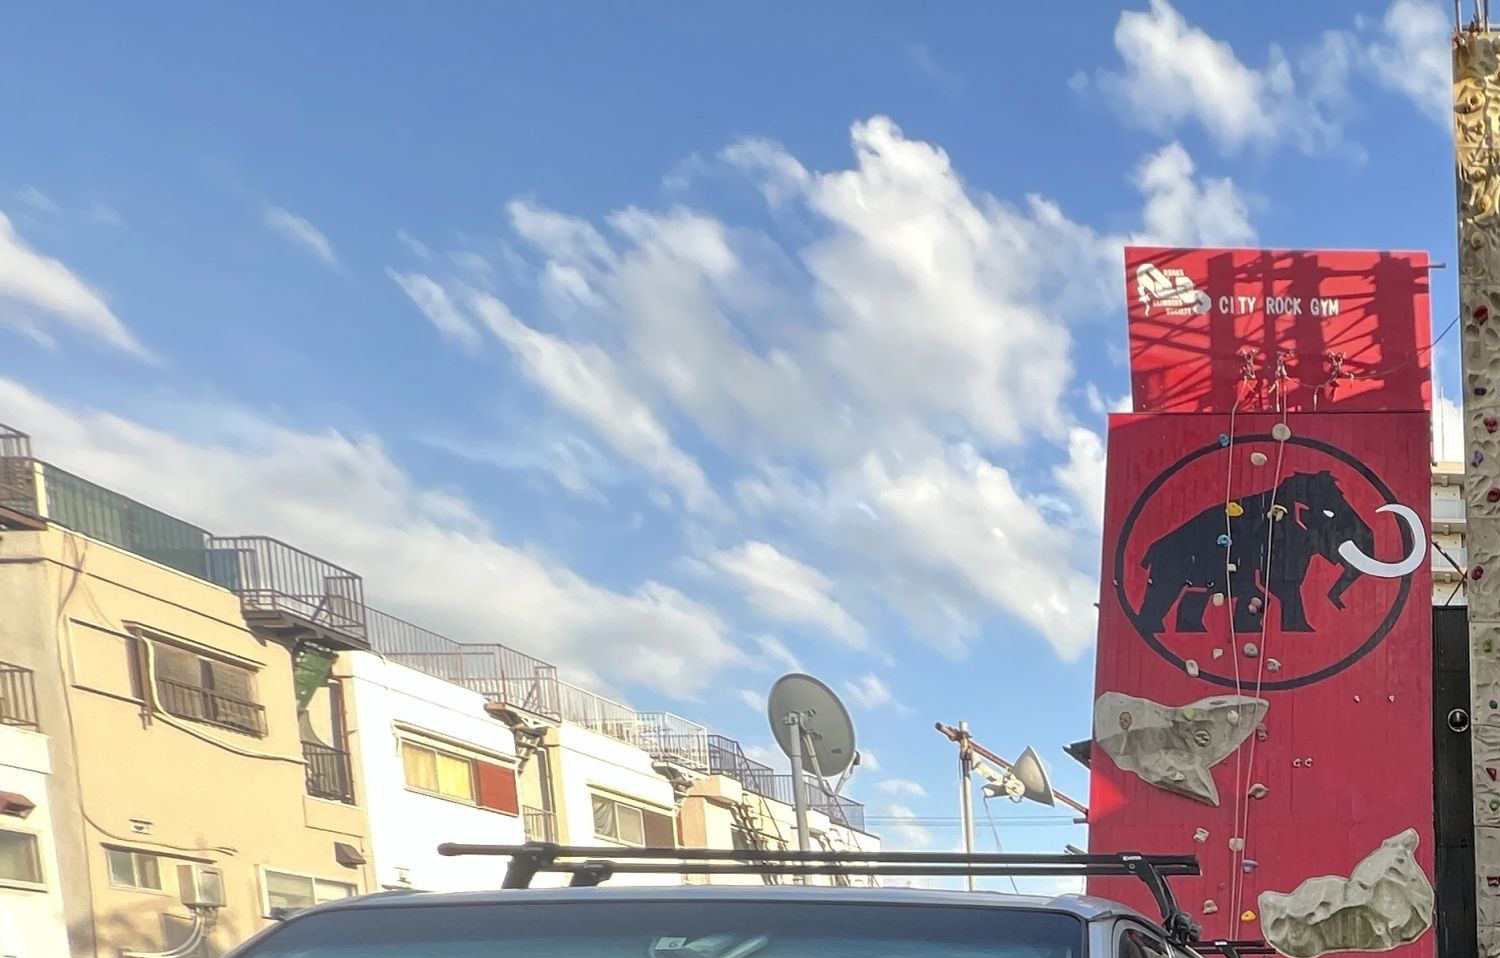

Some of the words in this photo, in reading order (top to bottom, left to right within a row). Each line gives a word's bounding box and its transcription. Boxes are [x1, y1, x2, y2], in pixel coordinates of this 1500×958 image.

[1219, 296, 1256, 314] CITY
[1266, 297, 1302, 315] ROCK
[1310, 298, 1339, 316] GYM
